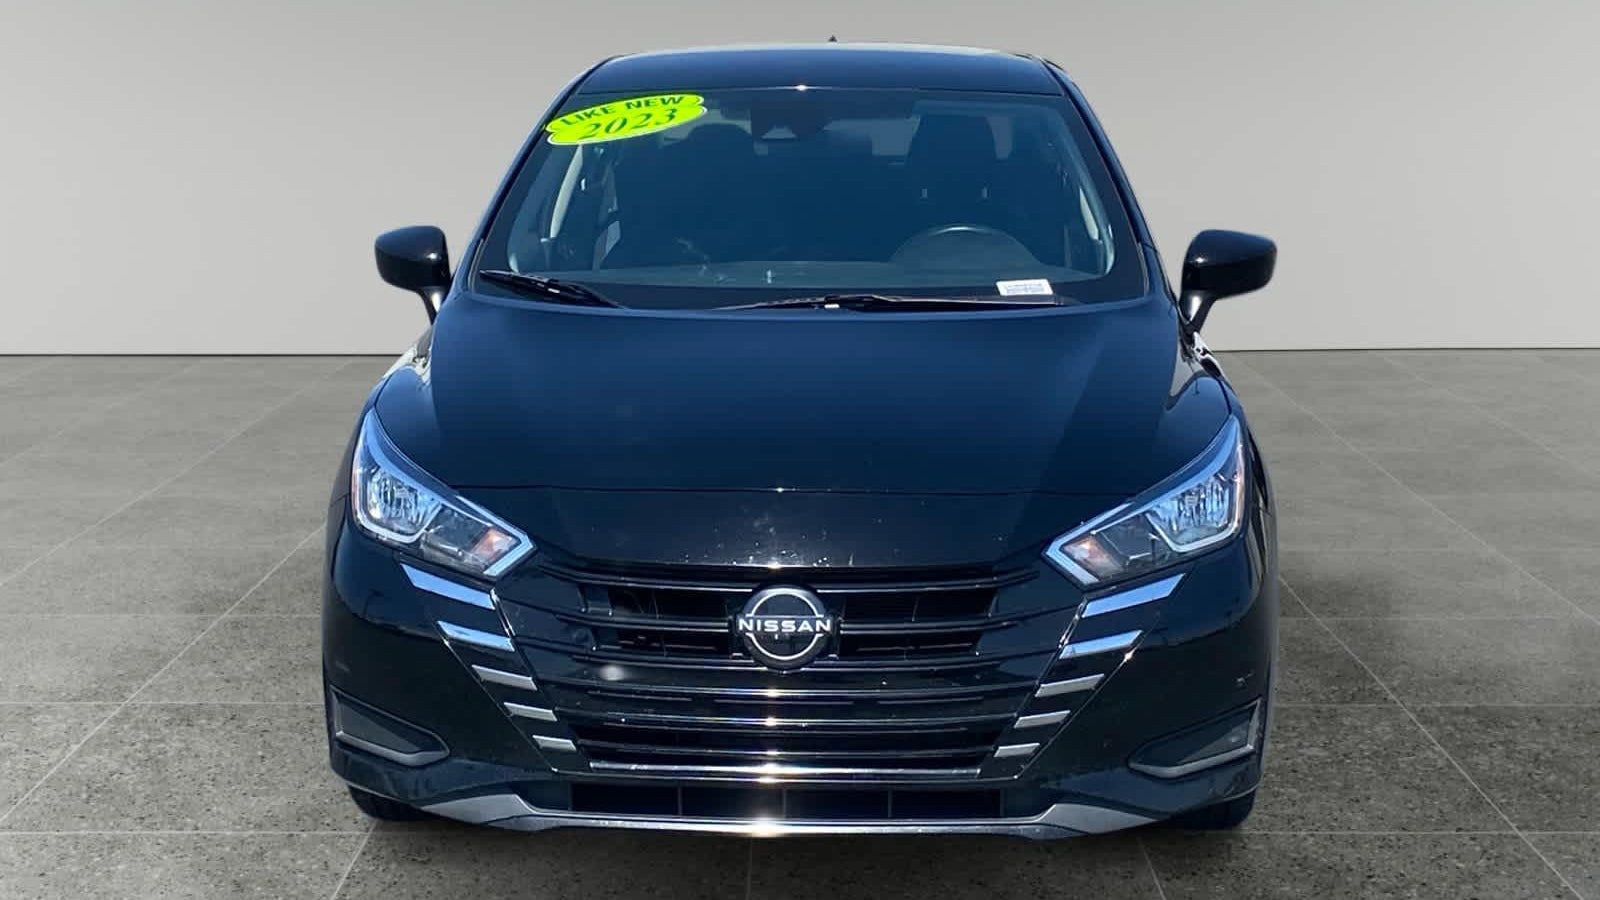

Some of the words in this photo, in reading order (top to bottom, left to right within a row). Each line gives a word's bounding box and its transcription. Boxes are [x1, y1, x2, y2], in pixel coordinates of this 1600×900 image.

[560, 105, 616, 126] LIKE
[625, 96, 684, 110] NEW
[578, 108, 678, 140] 2023
[738, 618, 831, 633] NISSAN
